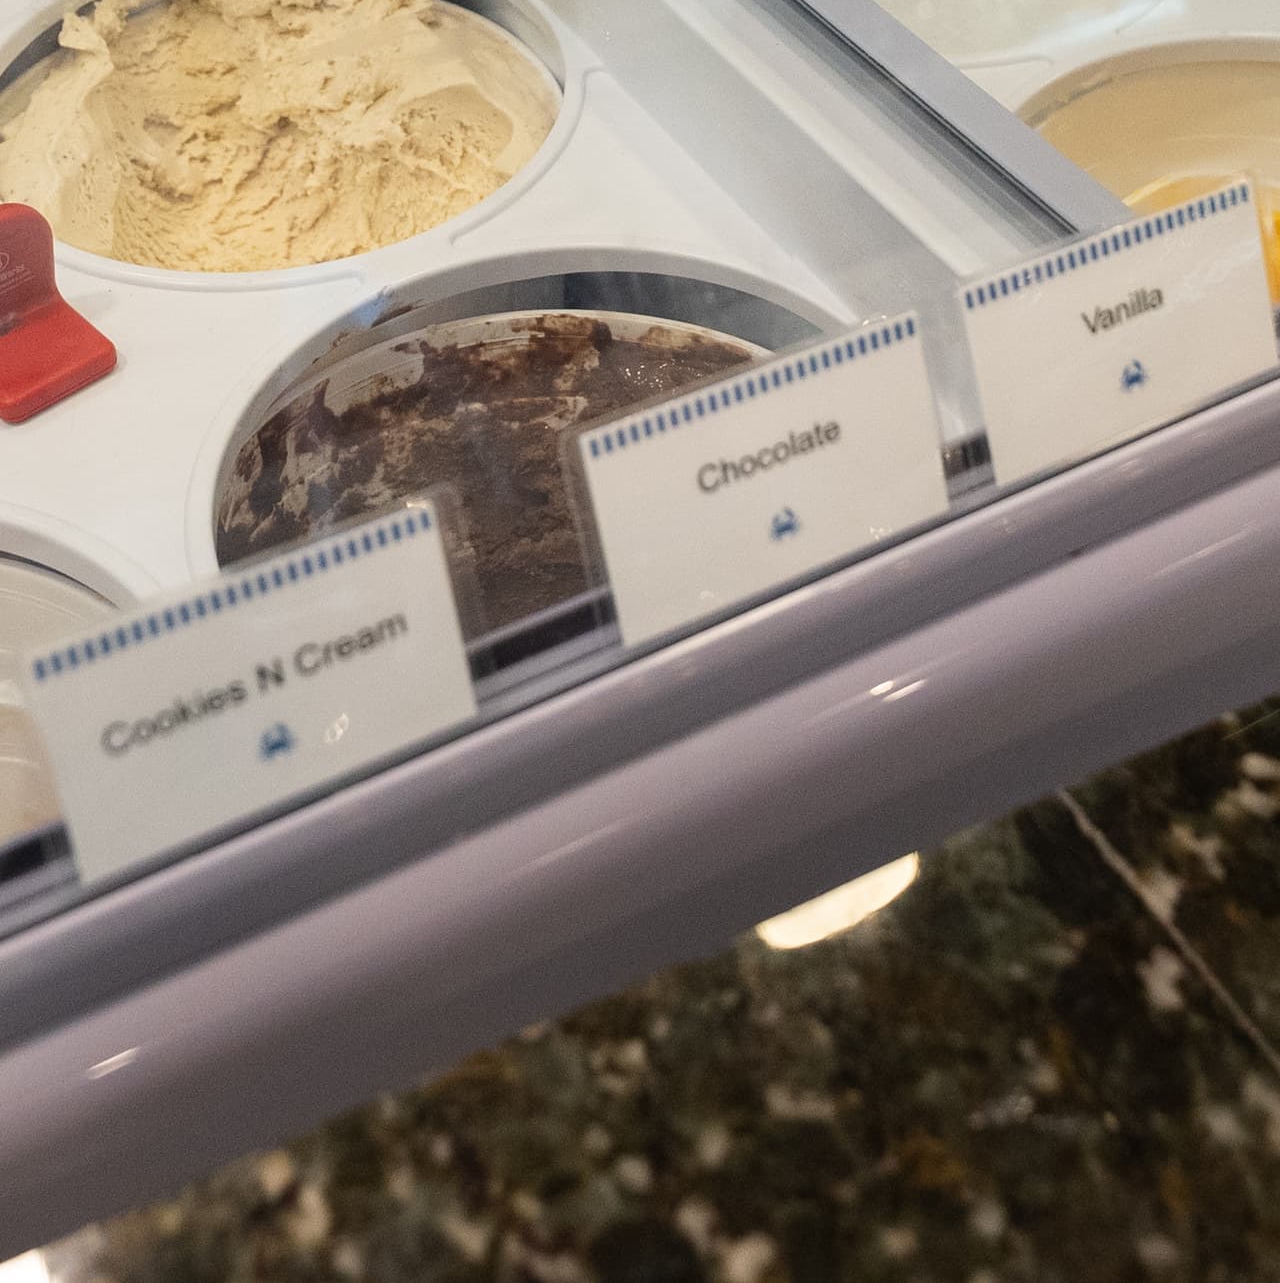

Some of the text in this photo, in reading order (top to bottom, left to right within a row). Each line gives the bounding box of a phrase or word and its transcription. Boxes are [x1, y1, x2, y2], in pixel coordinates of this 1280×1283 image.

[1080, 287, 1164, 334] Vanilla
[696, 421, 841, 493] Chocolate
[101, 614, 409, 757] Cookies N Cream
